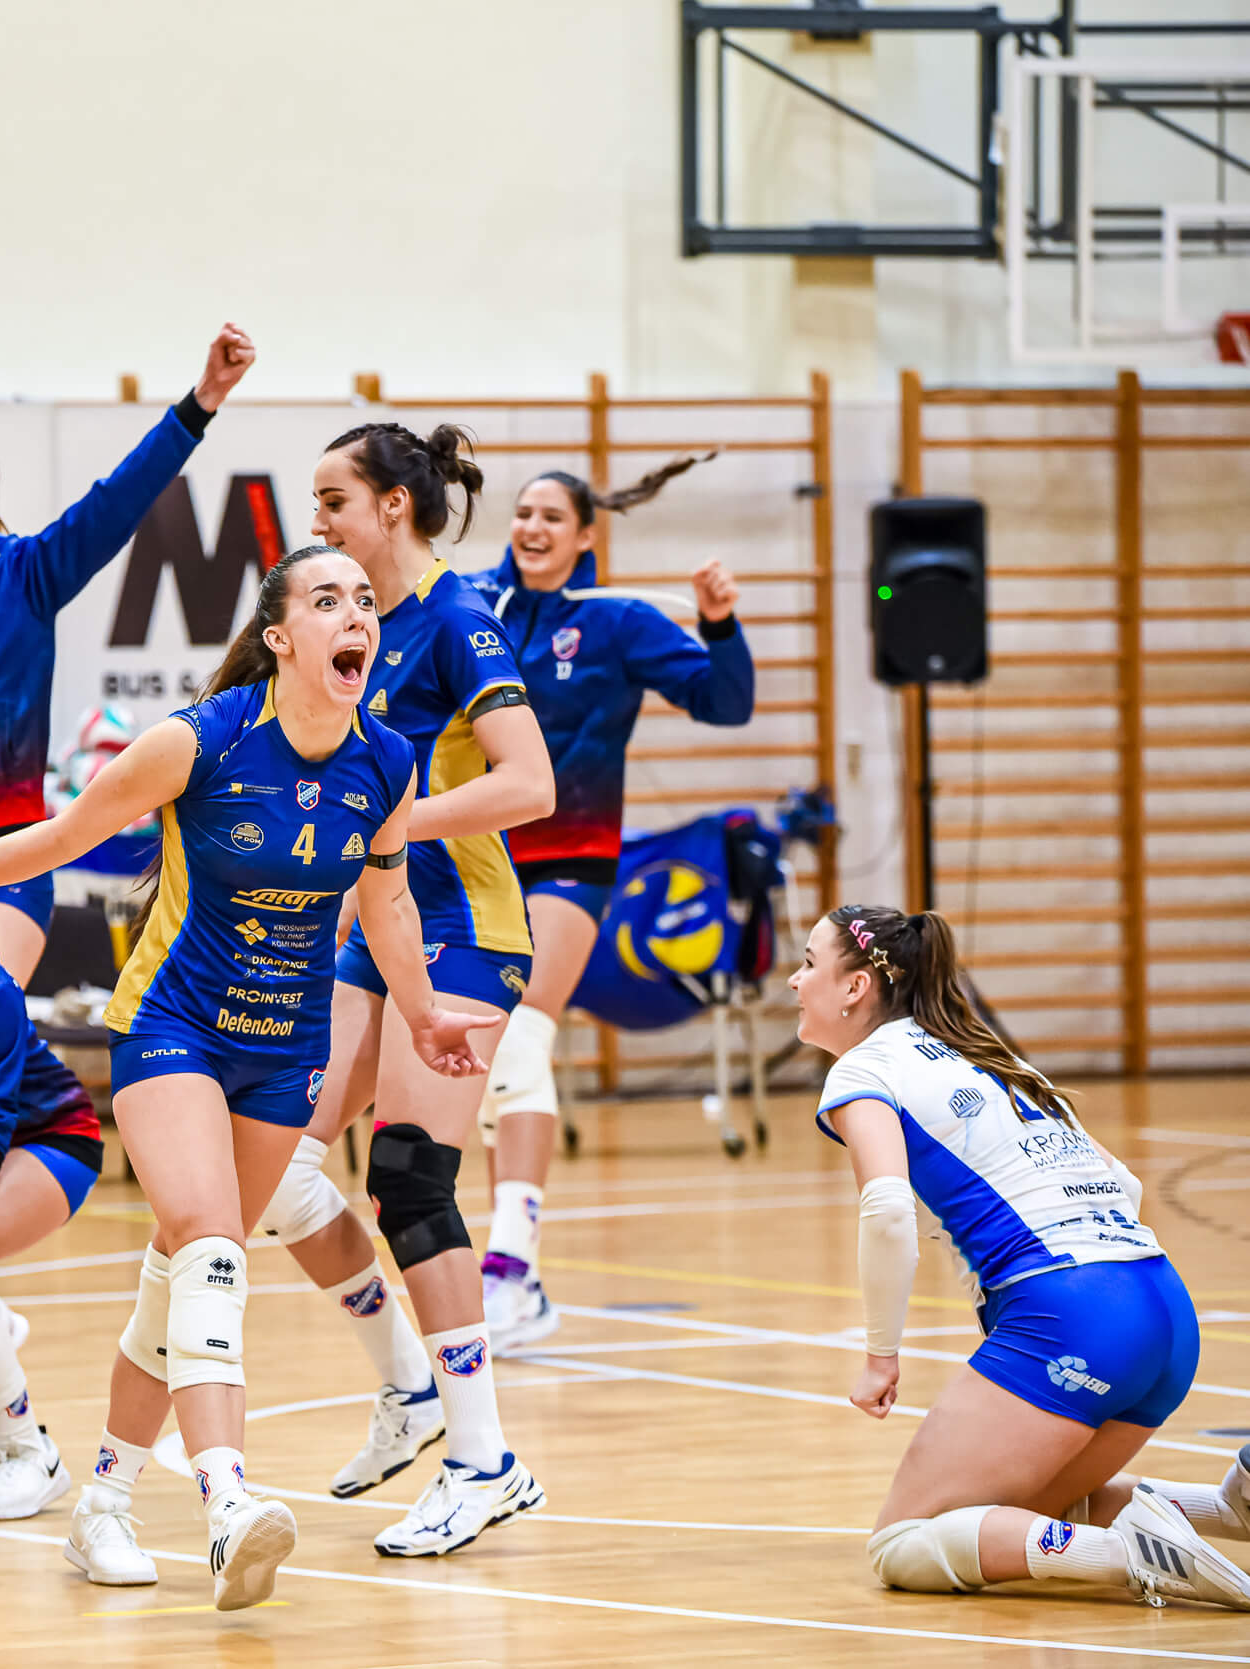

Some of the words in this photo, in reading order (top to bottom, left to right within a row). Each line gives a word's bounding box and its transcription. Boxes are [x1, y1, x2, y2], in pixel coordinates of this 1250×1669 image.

[468, 631, 500, 649] 100
[102, 672, 165, 697] BUS
[291, 823, 317, 865] 4
[227, 986, 304, 1004] PROINVEST
[141, 1048, 188, 1059] CUTLINE
[207, 1274, 234, 1286] errea
